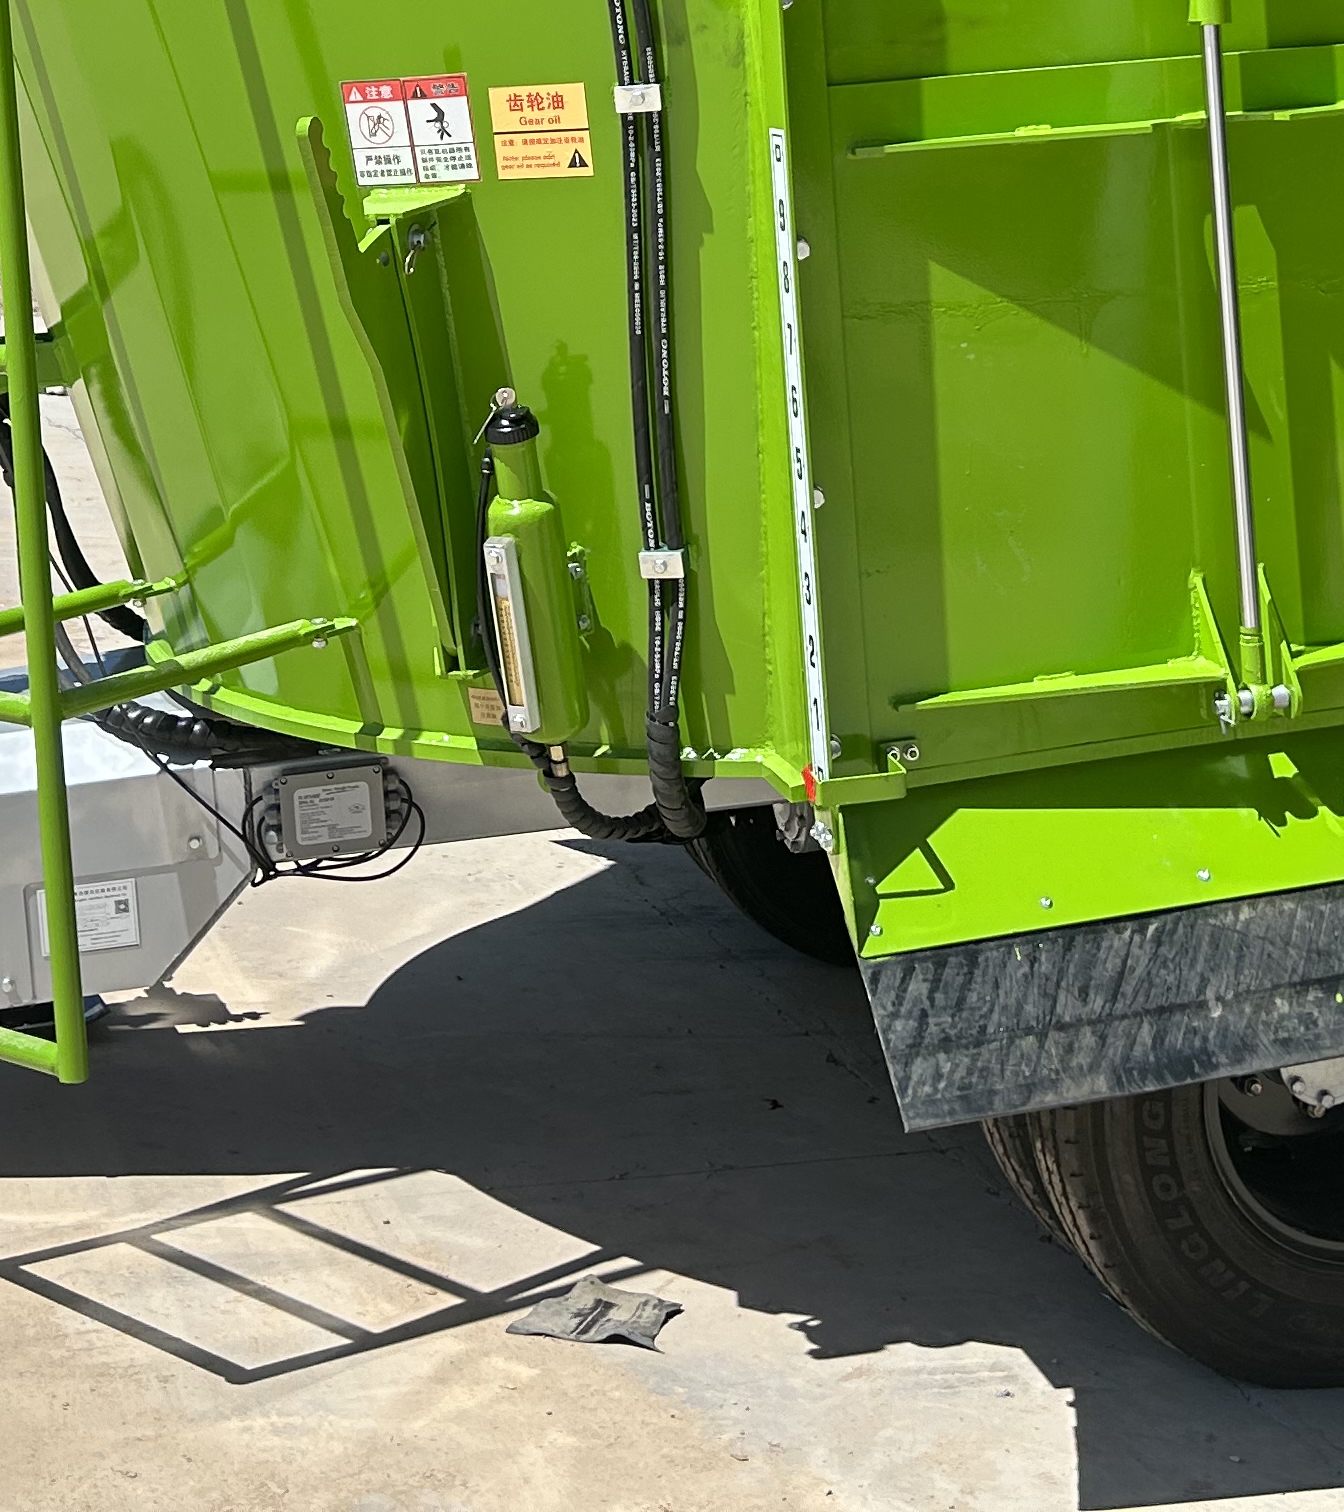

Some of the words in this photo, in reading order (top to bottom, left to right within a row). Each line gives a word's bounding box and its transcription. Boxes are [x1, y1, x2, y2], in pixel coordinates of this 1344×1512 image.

[365, 85, 394, 99] 注意
[505, 91, 565, 112] 齿轮油
[519, 116, 545, 126] Gear
[547, 115, 562, 125] oil
[779, 199, 786, 231] 9
[783, 261, 790, 293] 8
[787, 323, 793, 355] 7
[661, 339, 669, 396] BOTONG
[791, 385, 798, 418] 6
[795, 447, 803, 480] 5
[644, 503, 655, 551] BOTON
[801, 510, 807, 543] 4
[805, 572, 812, 605] 3
[809, 635, 816, 668] 2
[813, 697, 820, 731] 1
